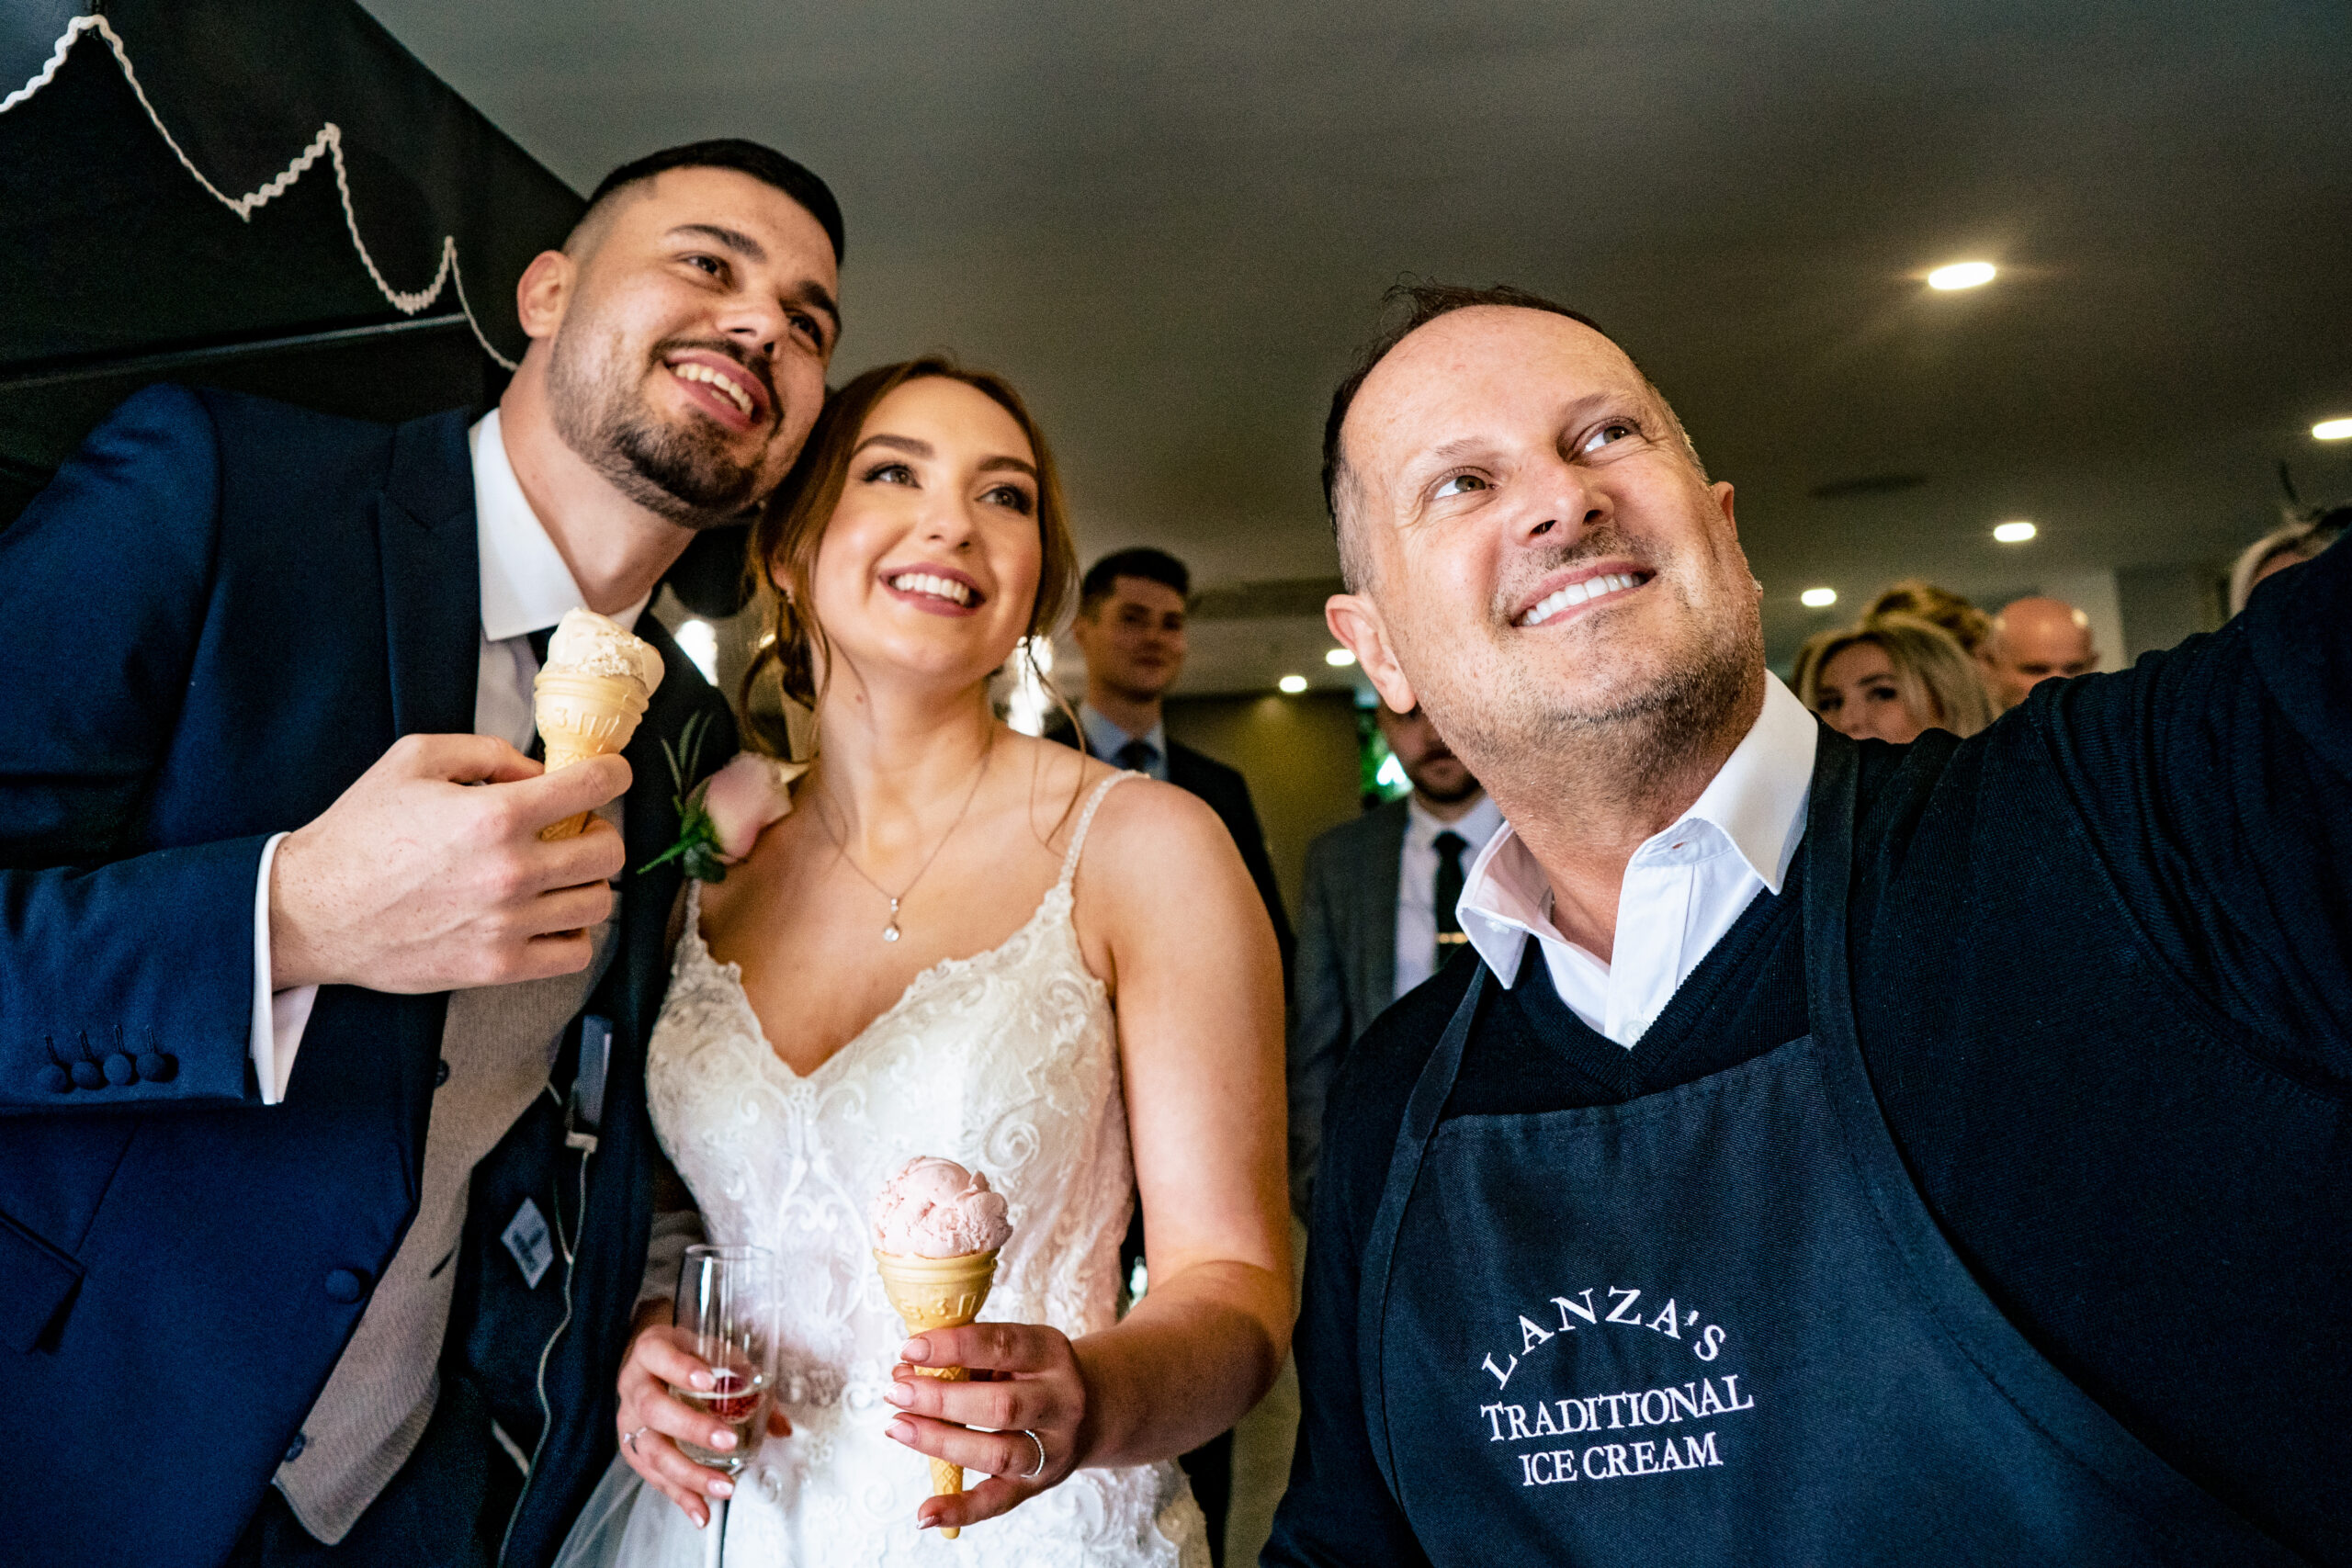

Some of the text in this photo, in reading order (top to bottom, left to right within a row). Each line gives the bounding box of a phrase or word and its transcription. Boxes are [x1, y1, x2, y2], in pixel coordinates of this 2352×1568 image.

[1481, 1285, 1726, 1391] LANZA'S
[1480, 1373, 1755, 1442] TRADITIONAL
[1518, 1431, 1724, 1486] ICE CREAM
